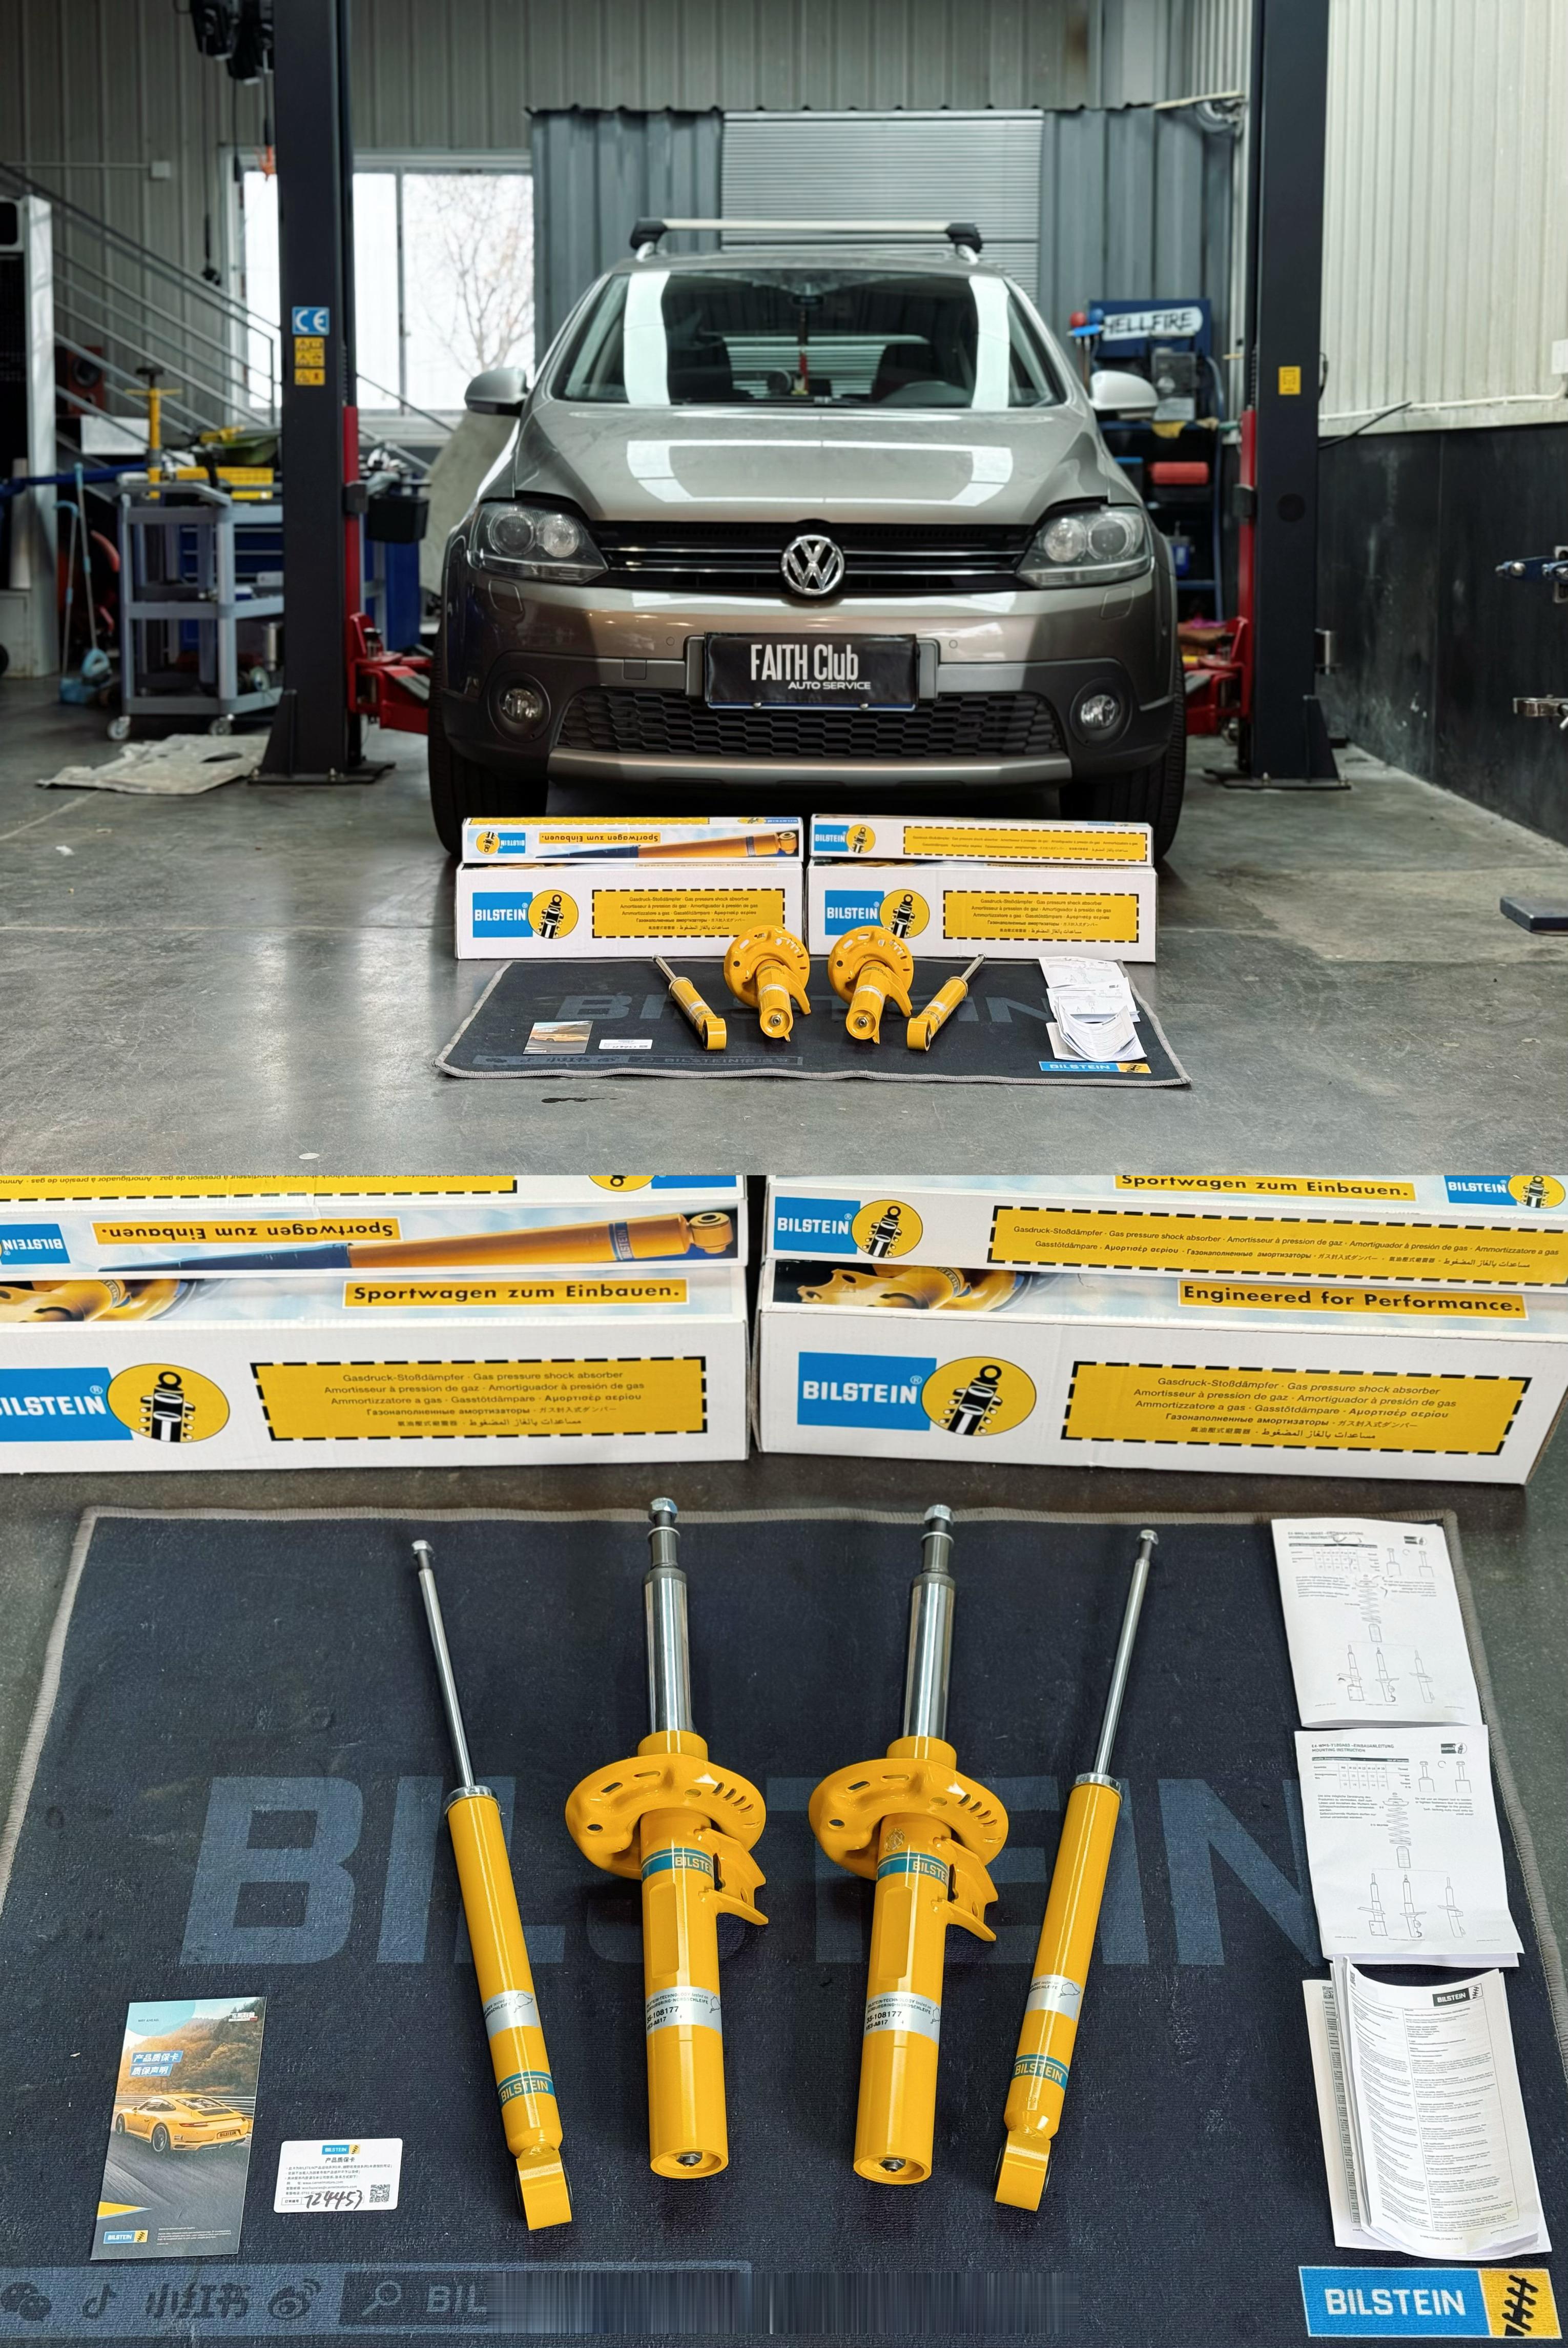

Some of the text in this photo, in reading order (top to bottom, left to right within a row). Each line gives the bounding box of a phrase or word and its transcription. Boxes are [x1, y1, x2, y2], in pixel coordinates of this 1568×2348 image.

[295, 310, 328, 331] CE
[751, 644, 859, 681] FAITH Club
[788, 681, 871, 690] AUTO SERVICE
[1122, 1175, 1408, 1197] Sportwagen zum Einbauen.
[102, 1220, 393, 1240] Sportwagen zum Einbauen.
[1014, 1226, 1103, 1237] Gasdruck-Stoßdämpfer
[1161, 1232, 1184, 1240] shock
[1186, 1234, 1221, 1242] absorber
[1349, 1240, 1403, 1250] Amortiguador
[1475, 1246, 1536, 1255] Ammortizzatore
[1187, 1249, 1311, 1260] Газонаполненные амортизаторы
[355, 1282, 680, 1302] Sportwagen zum Einbauen.
[1184, 1285, 1521, 1312] Engineered for Performance.
[497, 1373, 541, 1381] pressure
[1158, 1378, 1440, 1395] Gasdruck-Stoßdämpfer Gas pressure shock absorber
[399, 1385, 442, 1394] pression
[461, 1385, 479, 1393] gaz
[488, 1383, 558, 1393] Amortiguador
[570, 1383, 607, 1392] presión
[1133, 1389, 1196, 1398] Amortisseur
[1207, 1392, 1251, 1400] pression
[1296, 1395, 1369, 1405] Amortiguador
[1379, 1397, 1418, 1406] presión
[0, 1396, 107, 1416] ILSTEIN
[1136, 1400, 1215, 1411] Ammortizzatore
[1165, 1413, 1329, 1426] Газонаполненные амортизаторы
[913, 1861, 948, 1886] BILSTEI
[1437, 1992, 1467, 2004] BILSTEIN
[134, 2052, 179, 2063] 产品质保卡
[131, 2066, 169, 2075] 质保声明
[1015, 2063, 1063, 2084] BILSTEIN
[501, 2078, 548, 2102] BILSTEIN
[146, 2282, 252, 2320] 小红书
[1325, 2288, 1466, 2316] BILSTEIN
